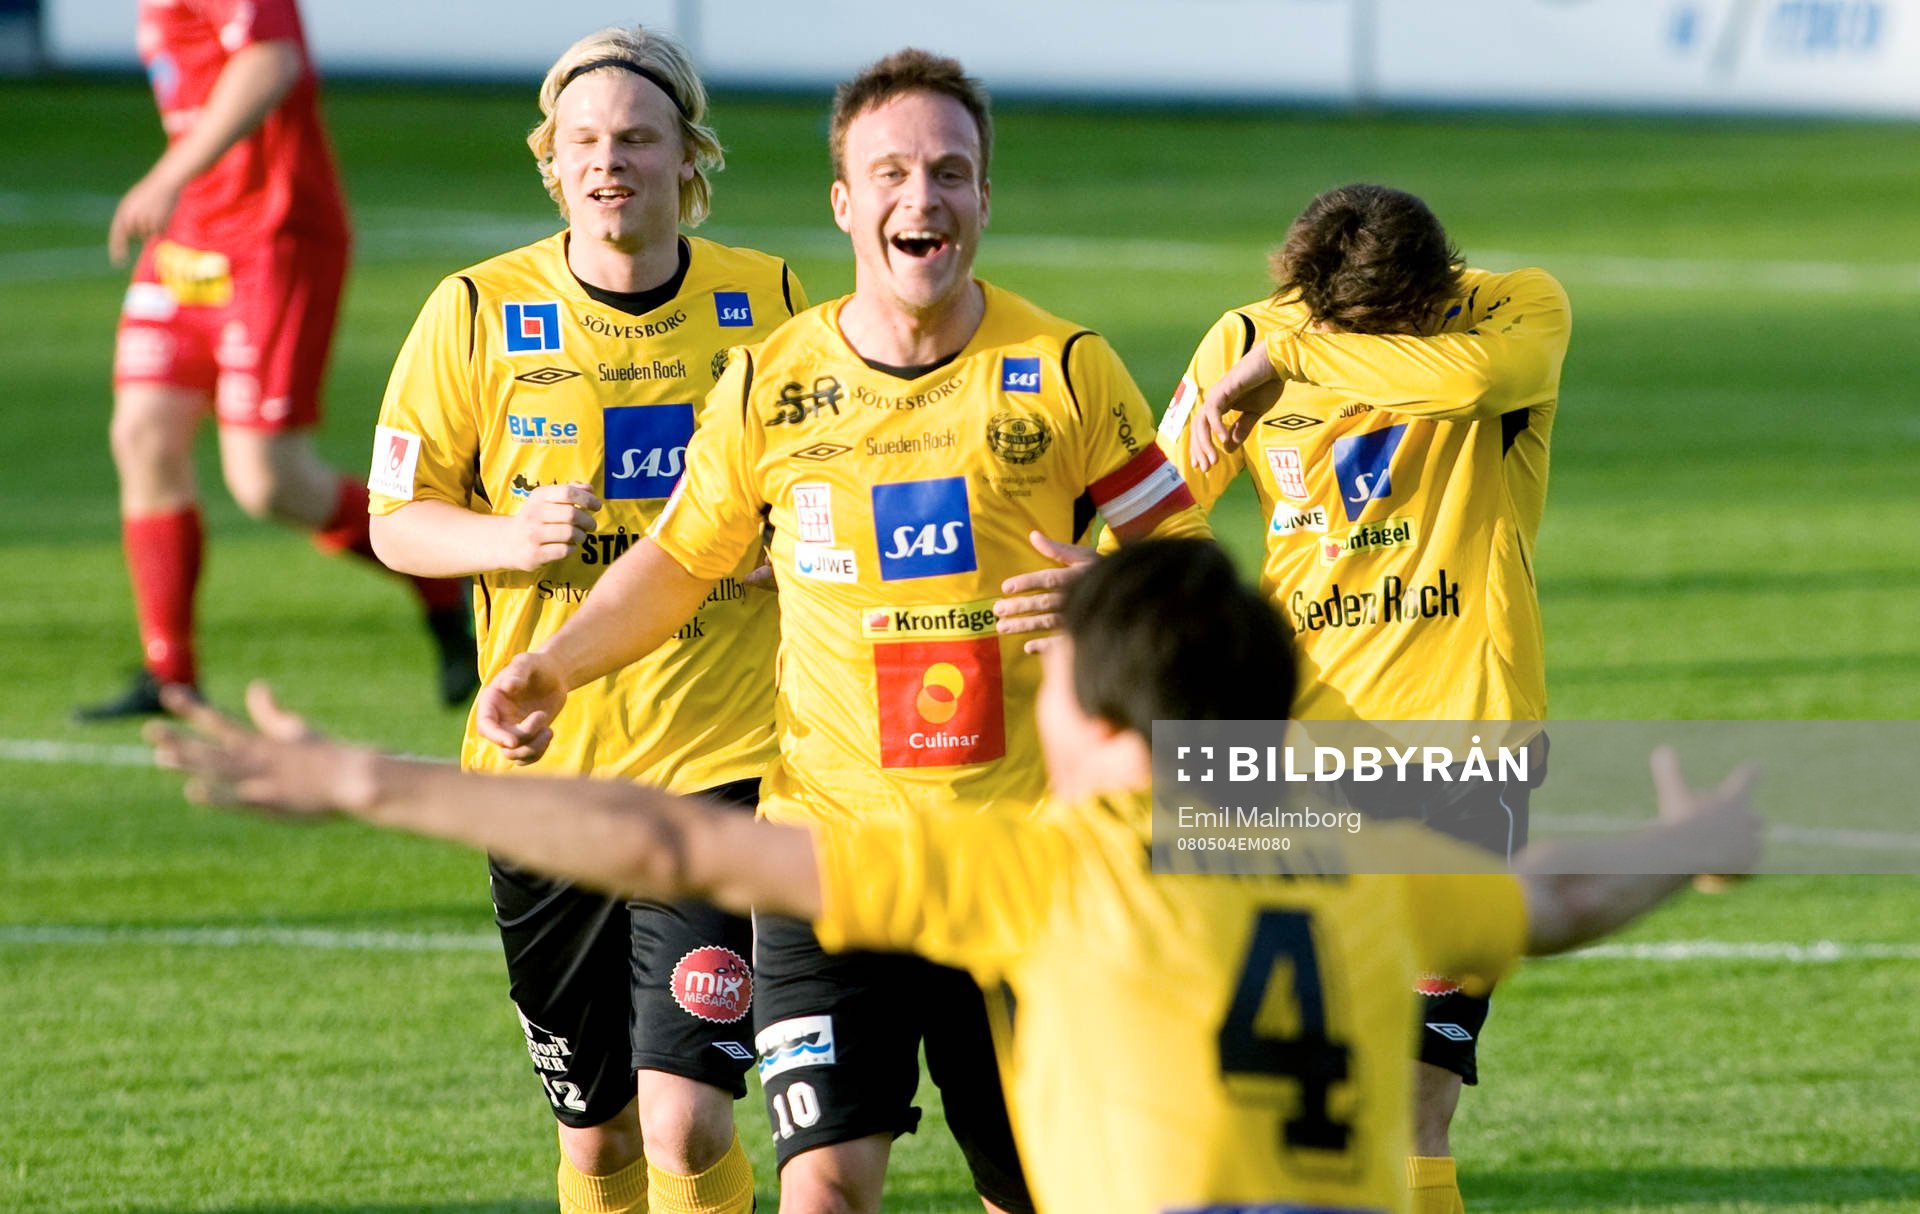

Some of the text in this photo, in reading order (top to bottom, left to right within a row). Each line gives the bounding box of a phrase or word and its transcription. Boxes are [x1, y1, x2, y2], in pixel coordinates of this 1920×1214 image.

[580, 309, 687, 338] SÖLVESBORG
[721, 307, 749, 320] SAS
[598, 359, 686, 381] Sweden Rock
[1005, 372, 1039, 386] SAS
[852, 376, 963, 411] SÖLVESBORG
[866, 429, 956, 456] Sweden Rock
[611, 446, 687, 480] SAS
[581, 526, 639, 565] STÅ
[884, 520, 964, 559] SAS
[814, 557, 853, 574] JIWE
[537, 579, 590, 603] Sölv
[1384, 569, 1460, 623] Rock
[895, 609, 1000, 632] Kronfåge
[909, 732, 980, 749] Culinar
[1217, 906, 1354, 1151] 4
[773, 1081, 821, 1140] 10
